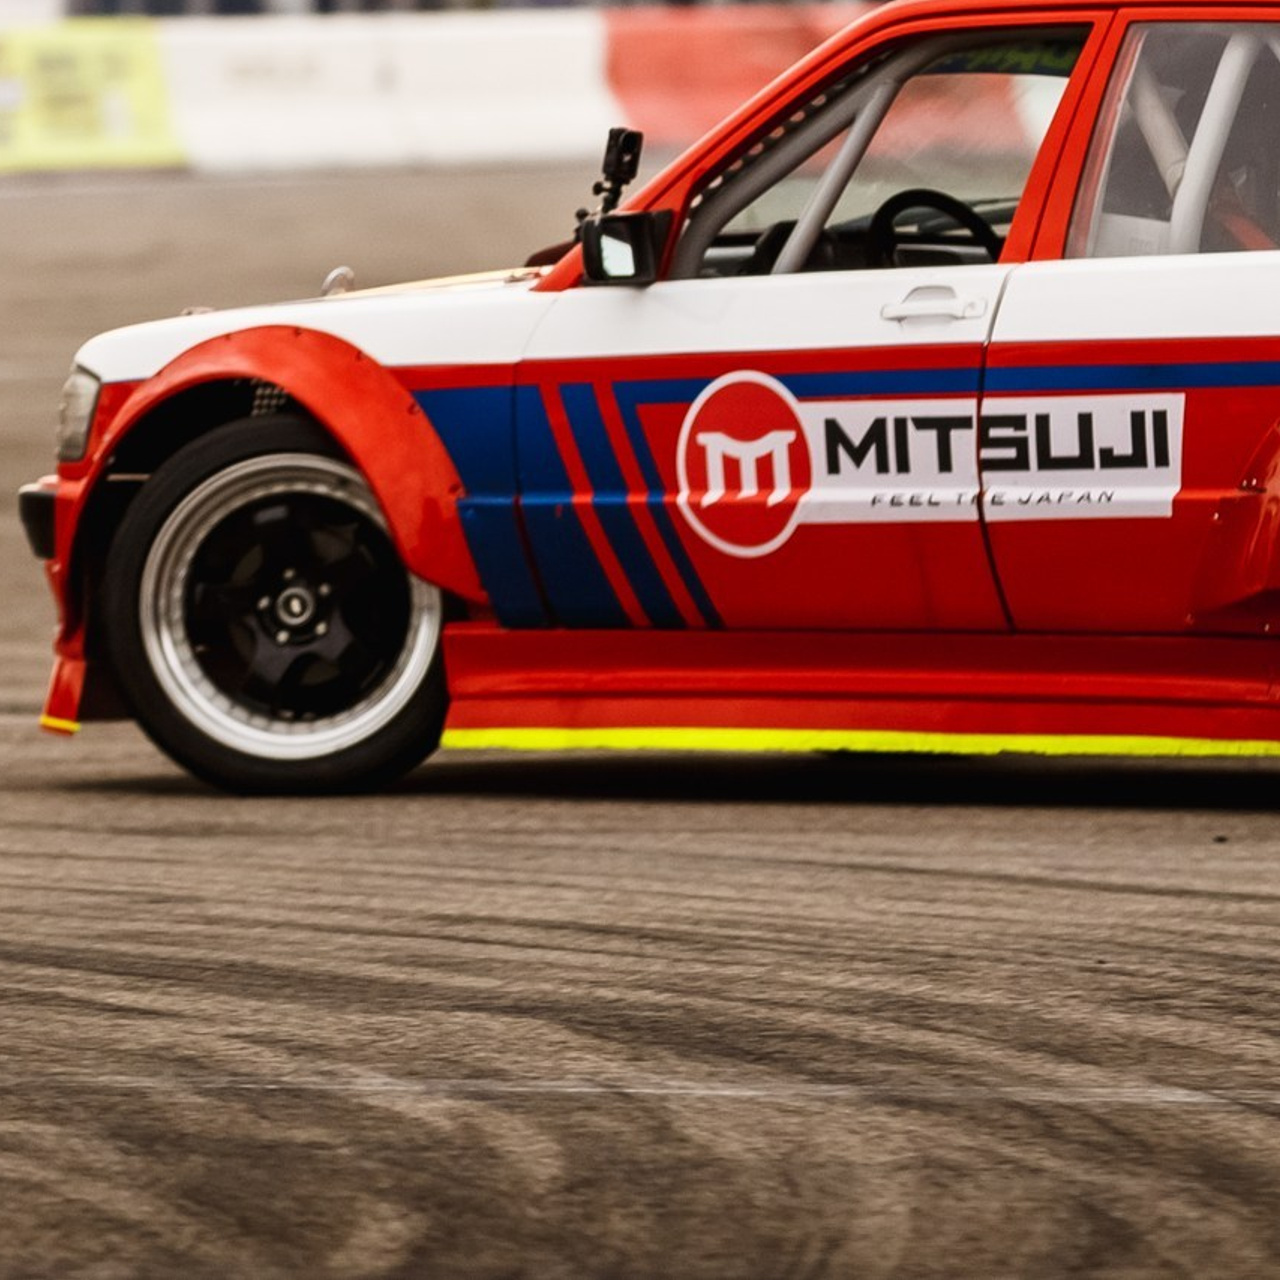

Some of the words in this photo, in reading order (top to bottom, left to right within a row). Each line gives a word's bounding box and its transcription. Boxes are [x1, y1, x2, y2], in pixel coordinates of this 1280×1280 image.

[823, 409, 1171, 476] MITSUJI
[870, 493, 942, 508] FEEL
[1017, 490, 1116, 506] JAPAN
